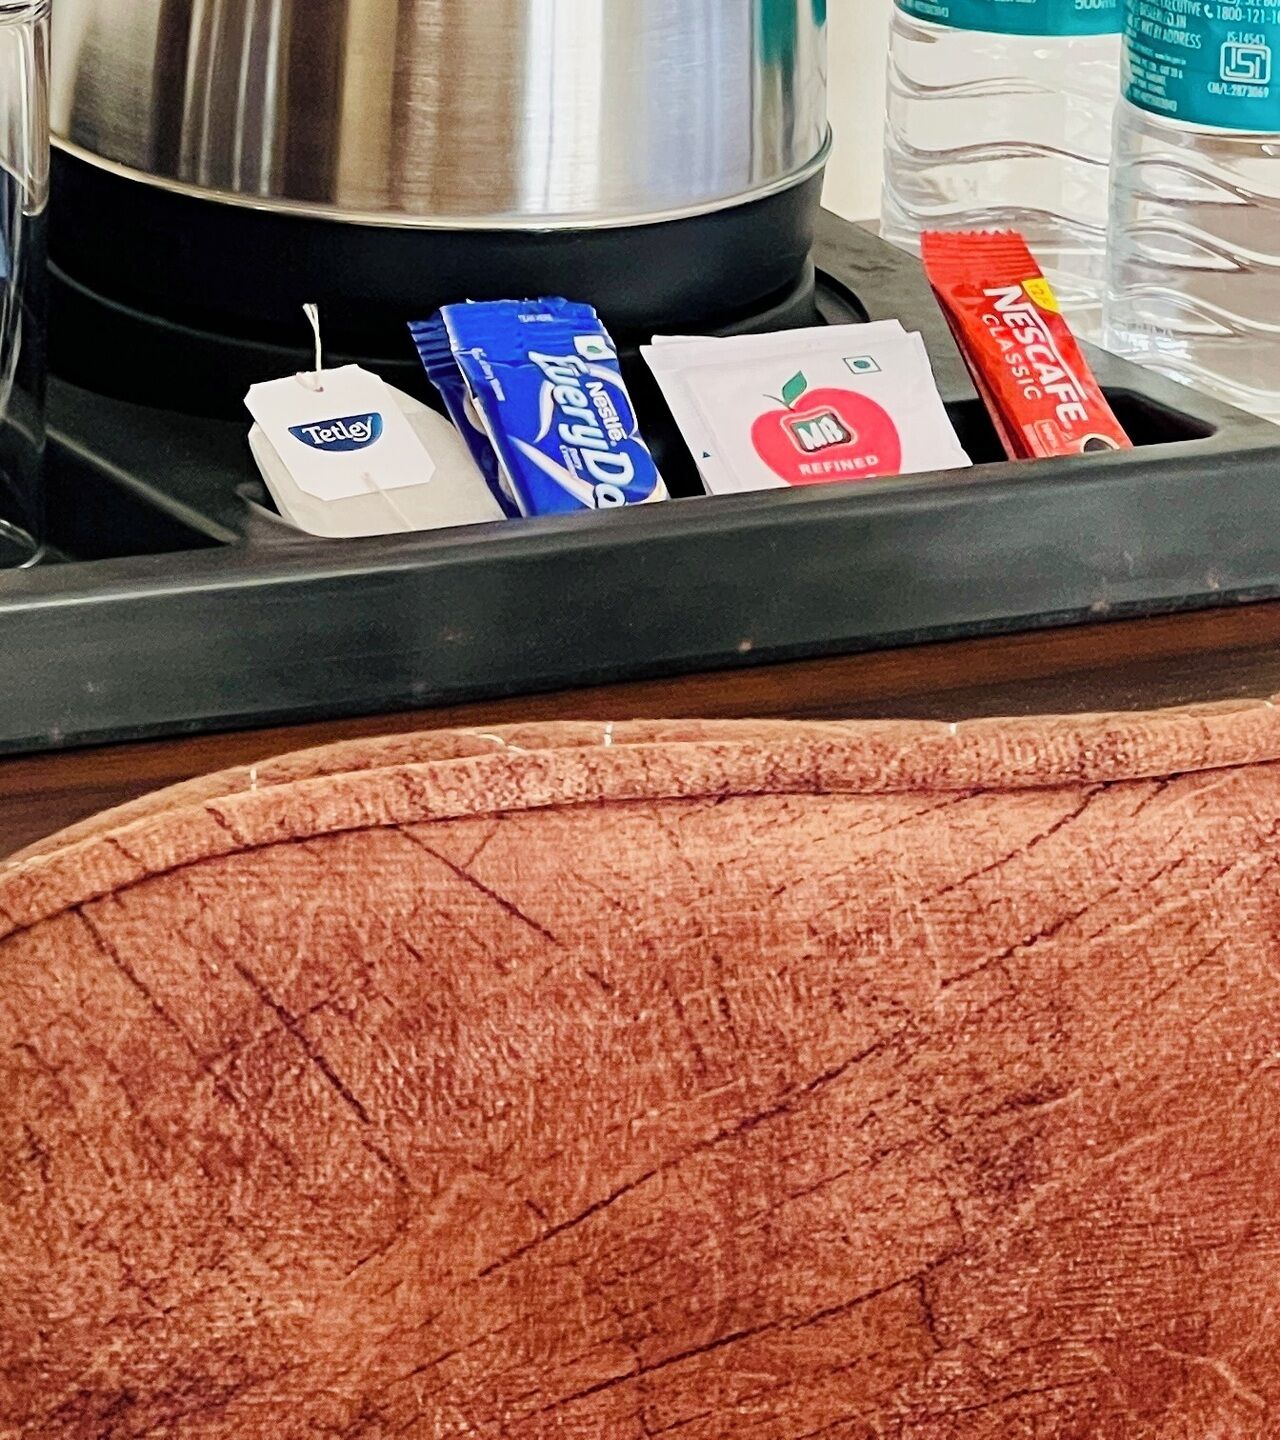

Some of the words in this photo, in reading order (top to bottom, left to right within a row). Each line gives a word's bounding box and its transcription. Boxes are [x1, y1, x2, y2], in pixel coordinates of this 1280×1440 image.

[1163, 28, 1202, 49] ADDRESS
[982, 314, 1042, 400] CLASSIC
[301, 416, 373, 445] Tetley
[528, 350, 627, 510] EveryDa
[799, 455, 879, 476] REFINED
